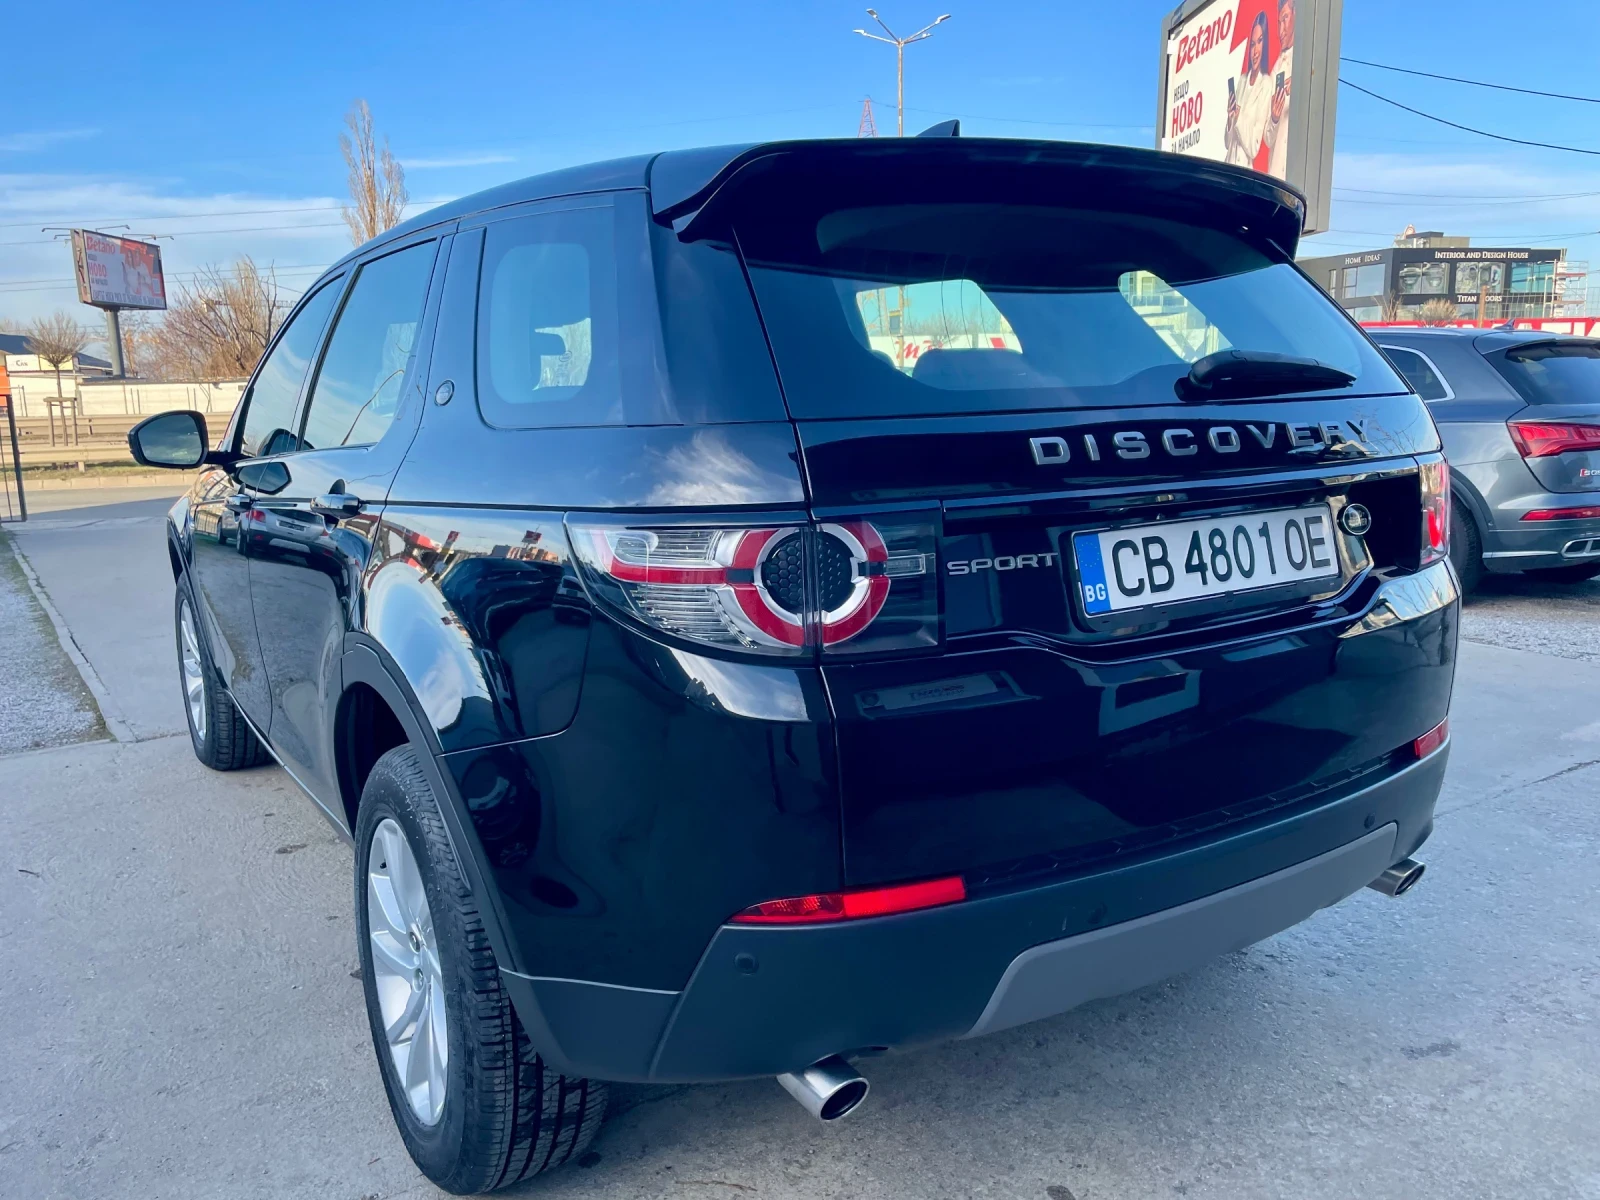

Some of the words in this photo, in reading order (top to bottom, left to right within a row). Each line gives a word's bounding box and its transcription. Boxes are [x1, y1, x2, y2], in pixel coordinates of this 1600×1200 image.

[1175, 9, 1233, 74] Betano
[1173, 80, 1190, 103] НЕЩО
[1171, 91, 1203, 138] НОВО
[1178, 128, 1201, 152] НАЧАЛО
[86, 236, 116, 254] Betano
[1434, 250, 1466, 259] INTERIOR
[1466, 251, 1481, 259] AND
[1482, 250, 1507, 259] DESIGN
[1507, 251, 1529, 259] HOUSE
[1345, 256, 1362, 265] HOME
[1364, 253, 1382, 263] IDEAS
[1457, 295, 1477, 303] TITAN
[1028, 418, 1370, 466] DISCOVERY
[946, 552, 1059, 577] SPORT
[1111, 535, 1175, 598] CB
[1184, 520, 1277, 587] 4801
[1084, 583, 1108, 602] BG
